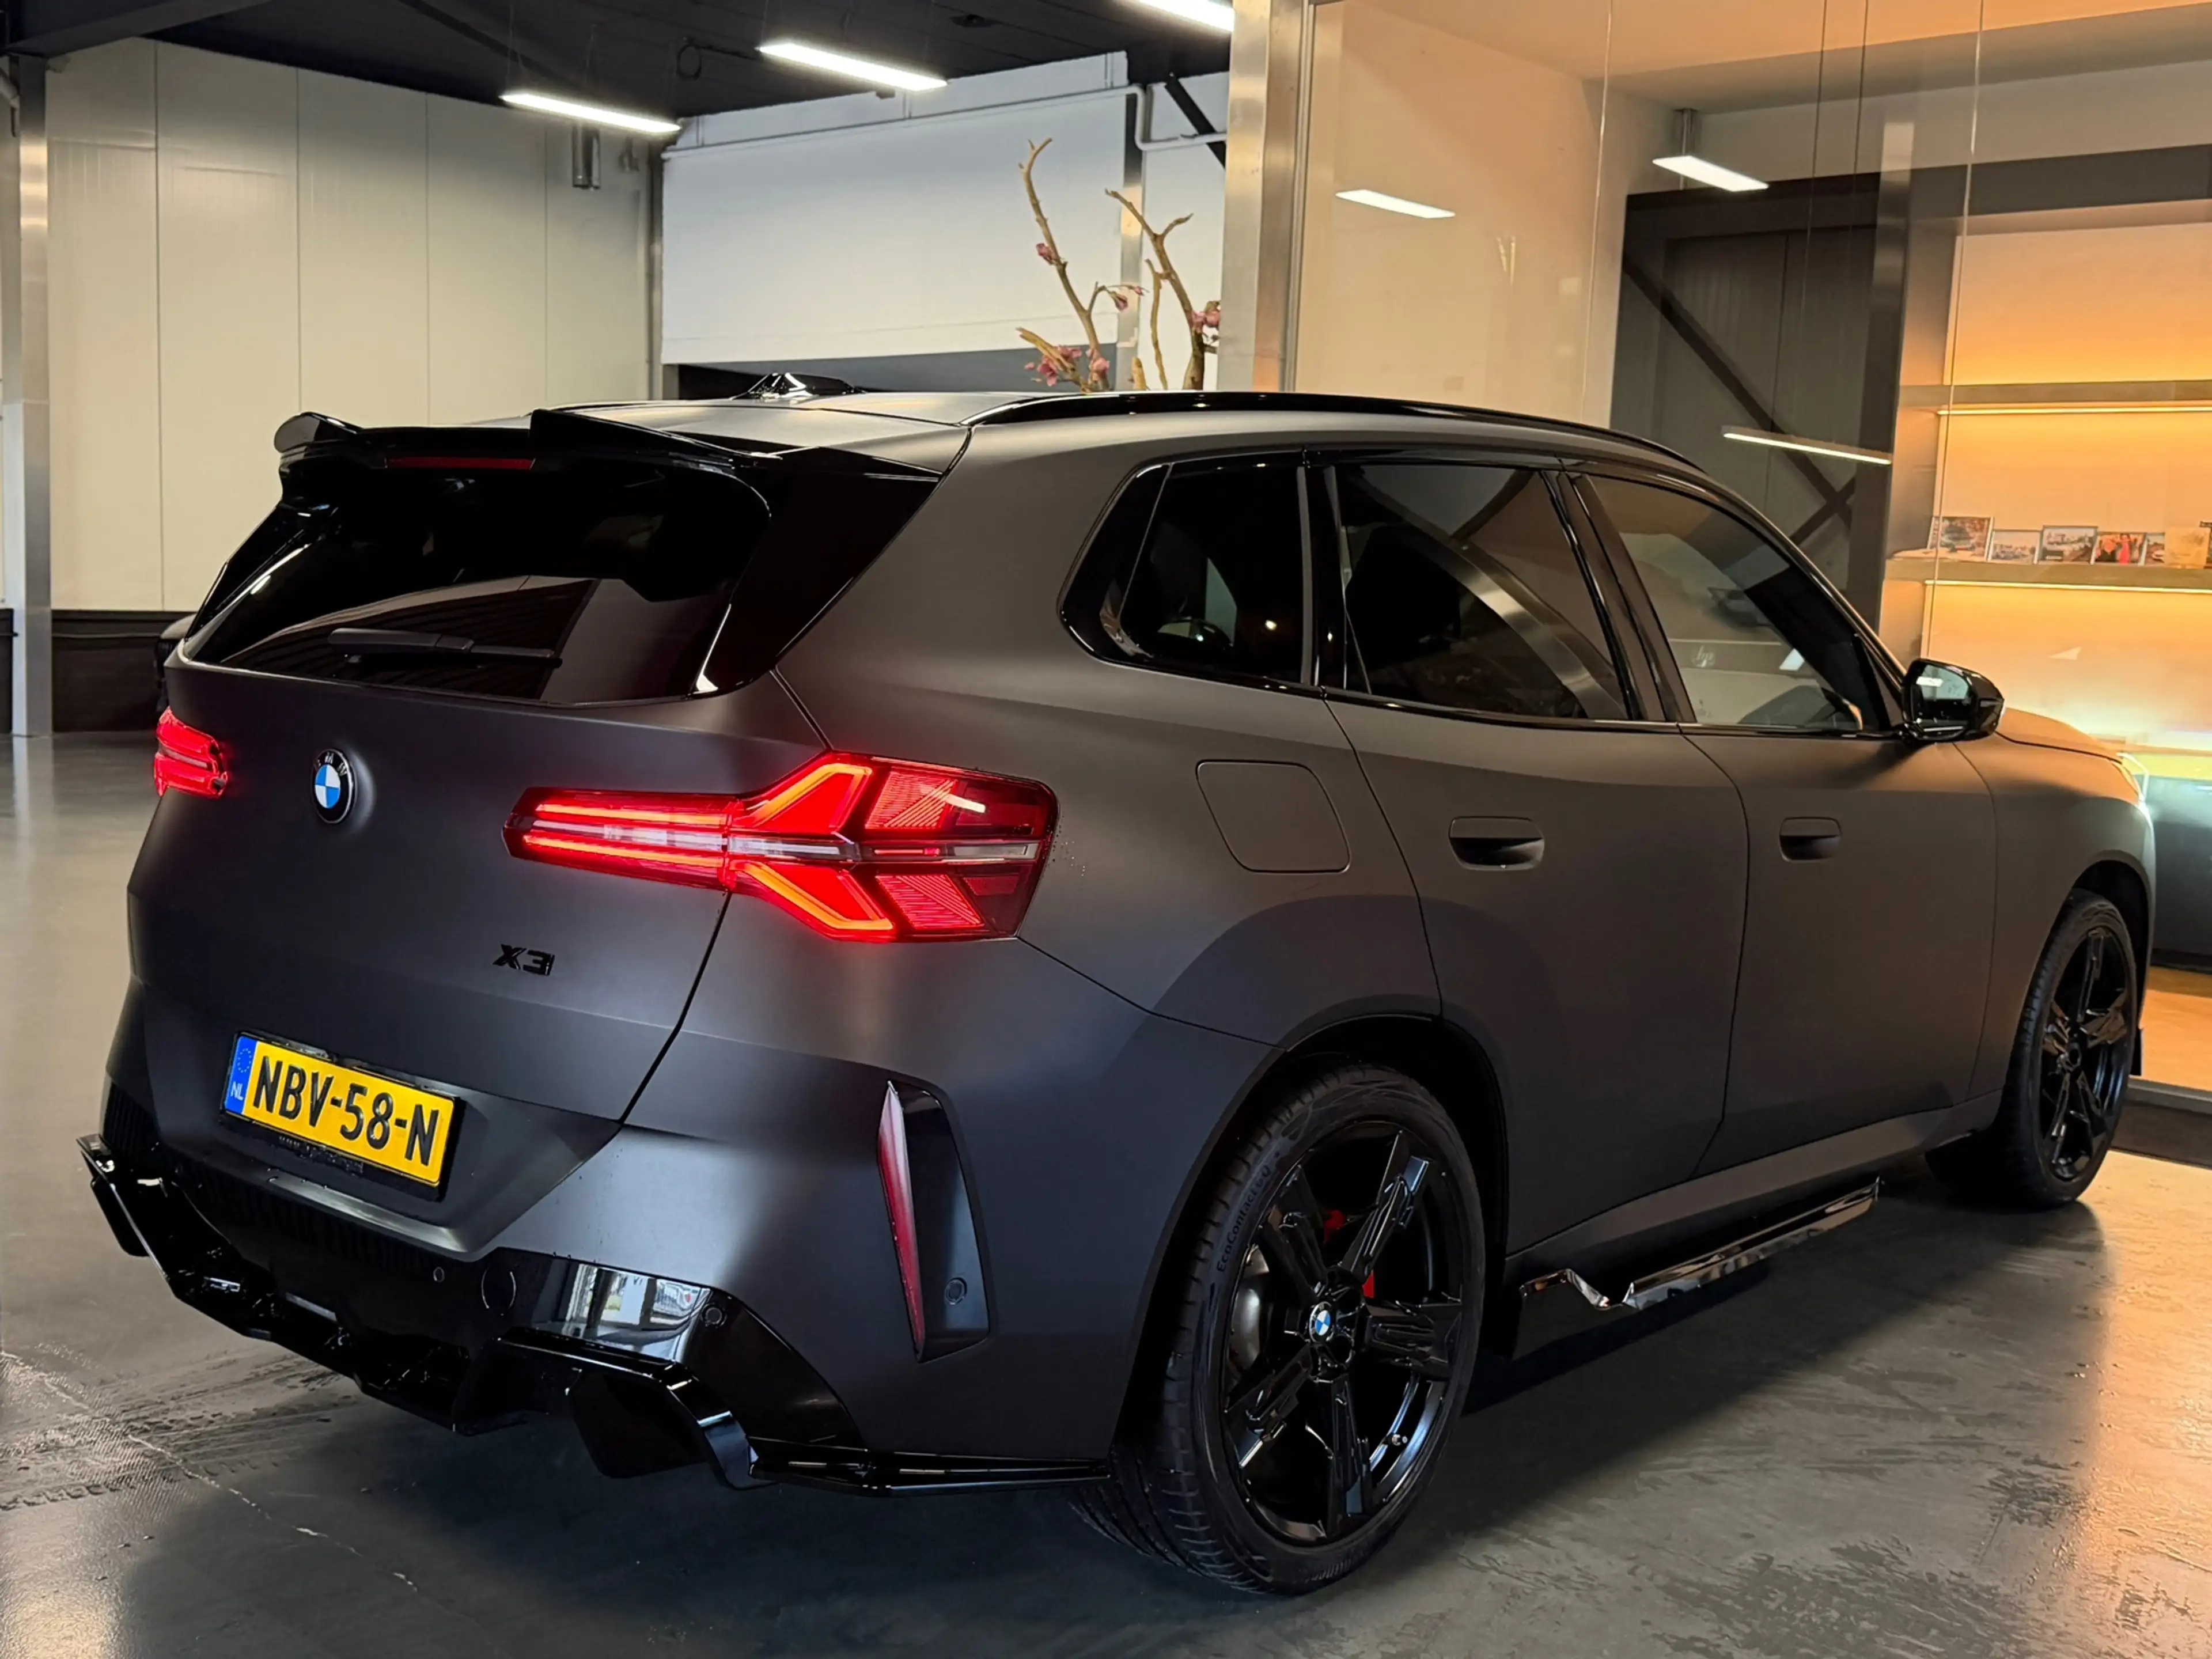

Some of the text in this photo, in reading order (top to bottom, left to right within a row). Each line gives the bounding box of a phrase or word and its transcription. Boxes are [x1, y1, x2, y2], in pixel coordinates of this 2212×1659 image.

[493, 944, 555, 976] X3
[230, 1081, 244, 1101] NL
[253, 1055, 440, 1166] NBV-58-N
[1217, 1187, 1257, 1272] EcoContact
